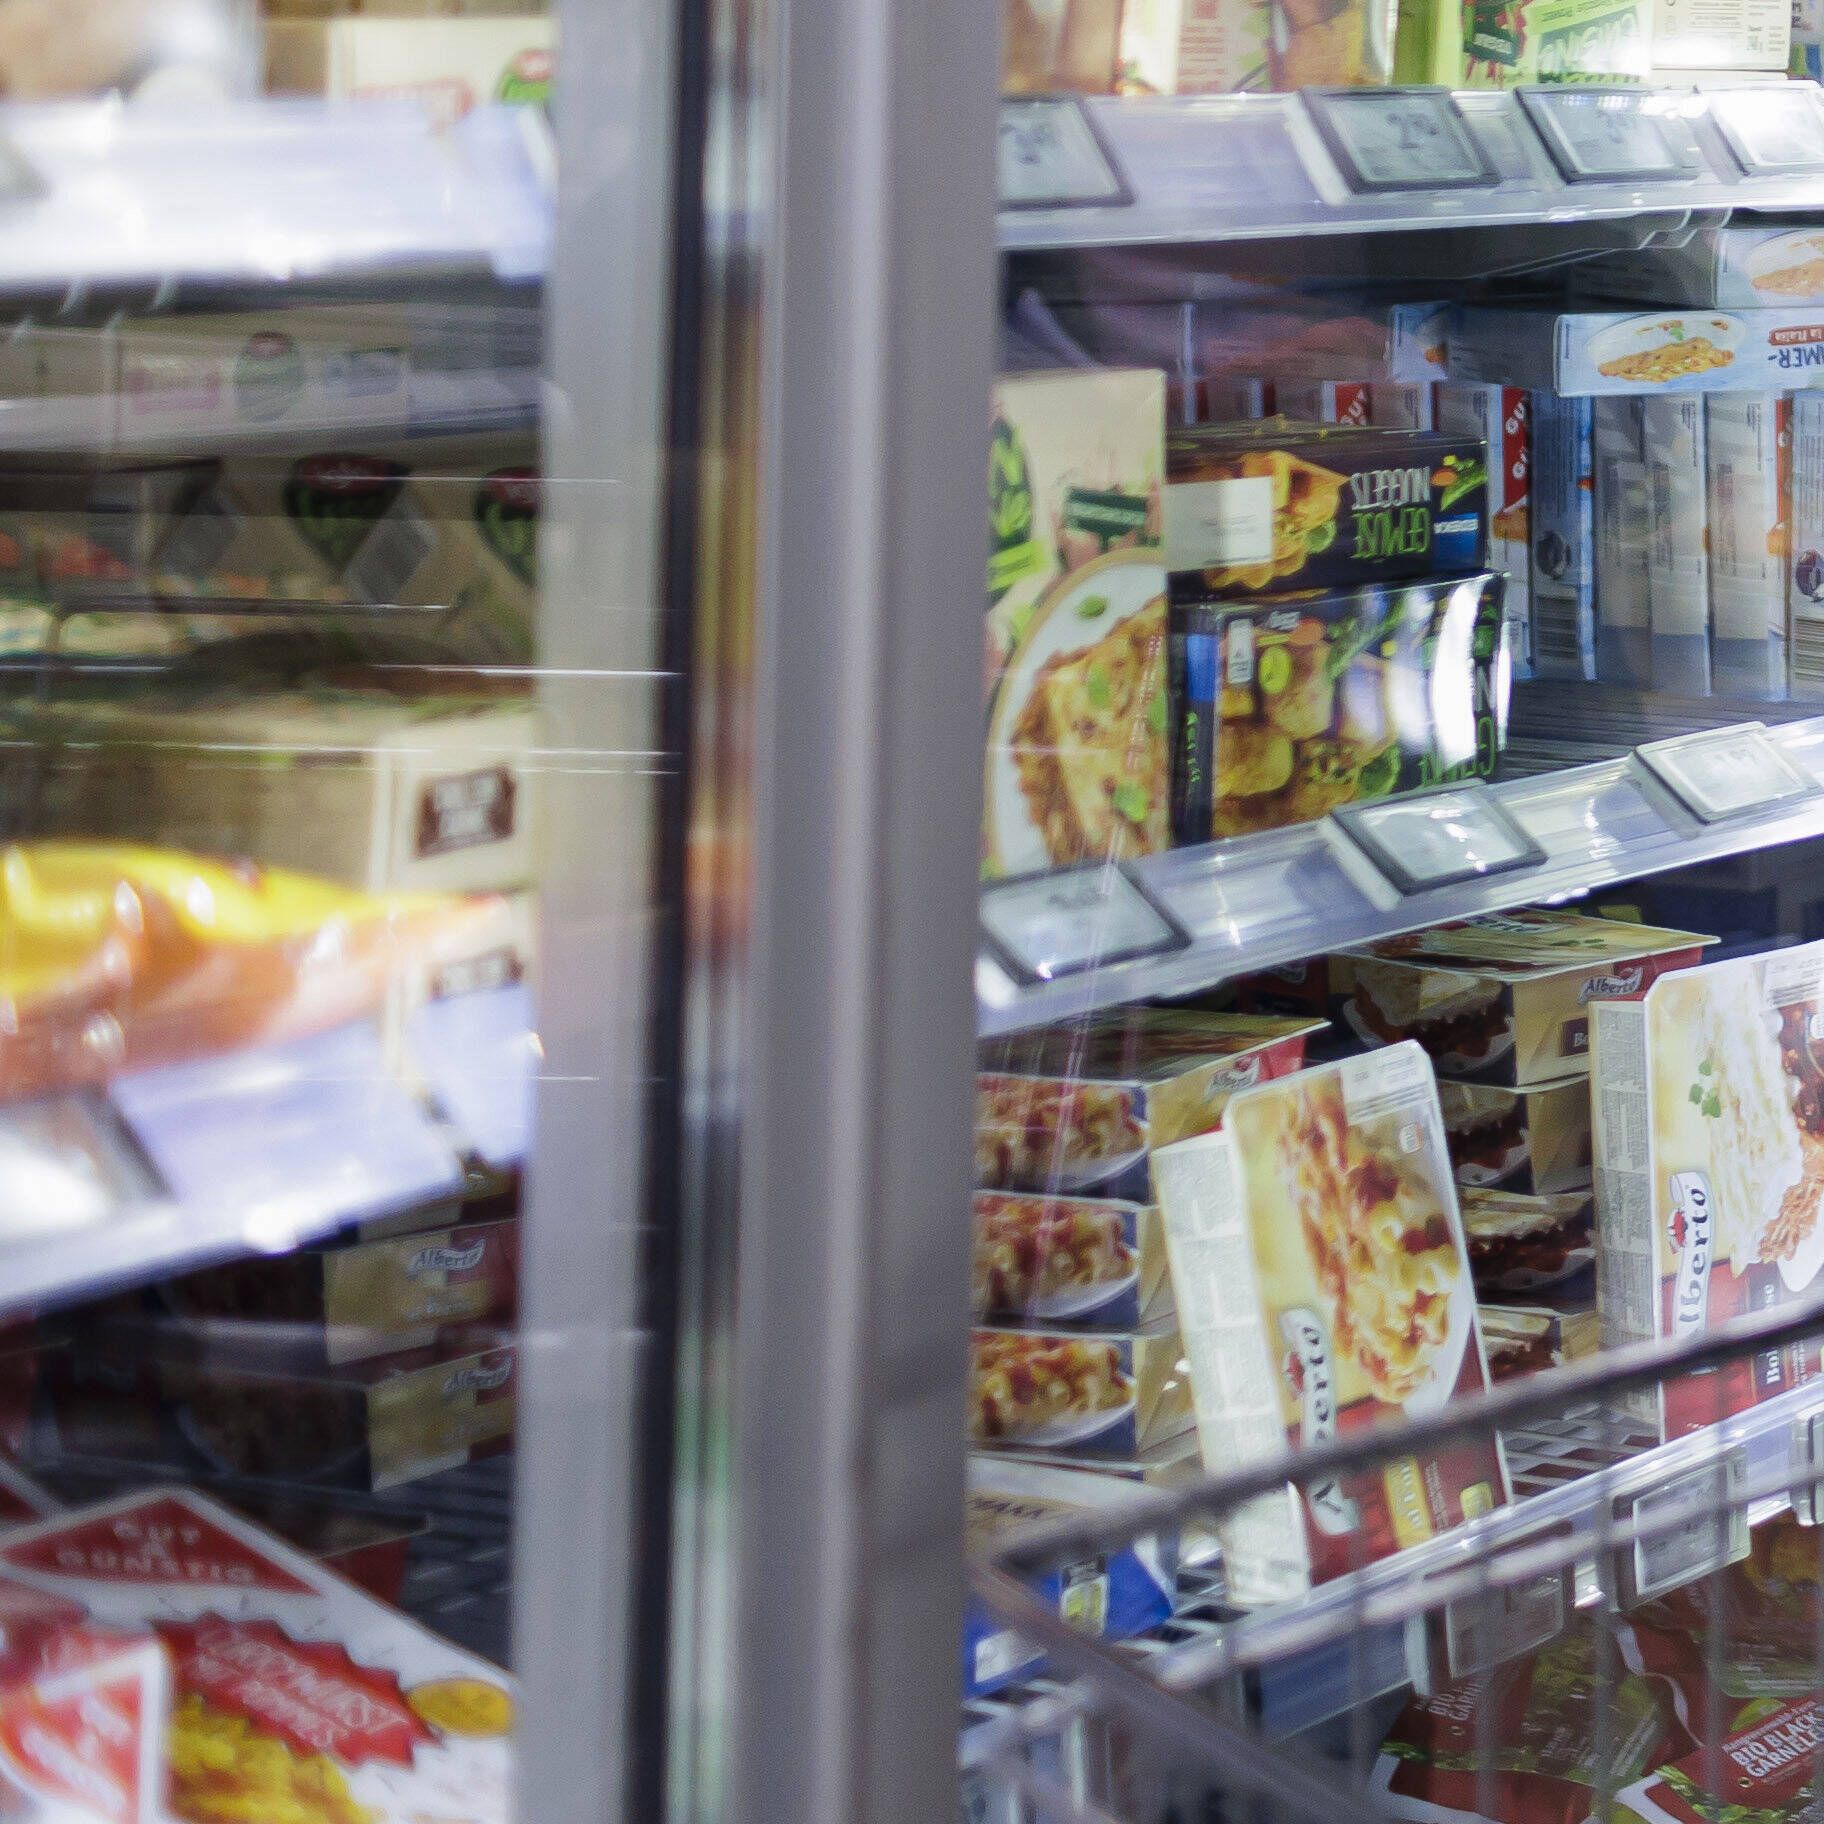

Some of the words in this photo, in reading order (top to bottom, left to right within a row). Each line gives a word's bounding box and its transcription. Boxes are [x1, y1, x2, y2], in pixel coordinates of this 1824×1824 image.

[1350, 466, 1431, 511] NUGGETS
[1350, 507, 1431, 561] GEMÜSE
[1584, 976, 1639, 995] Alberto
[1730, 1742, 1771, 1767] BIO
[1767, 1708, 1823, 1750] BLACK
